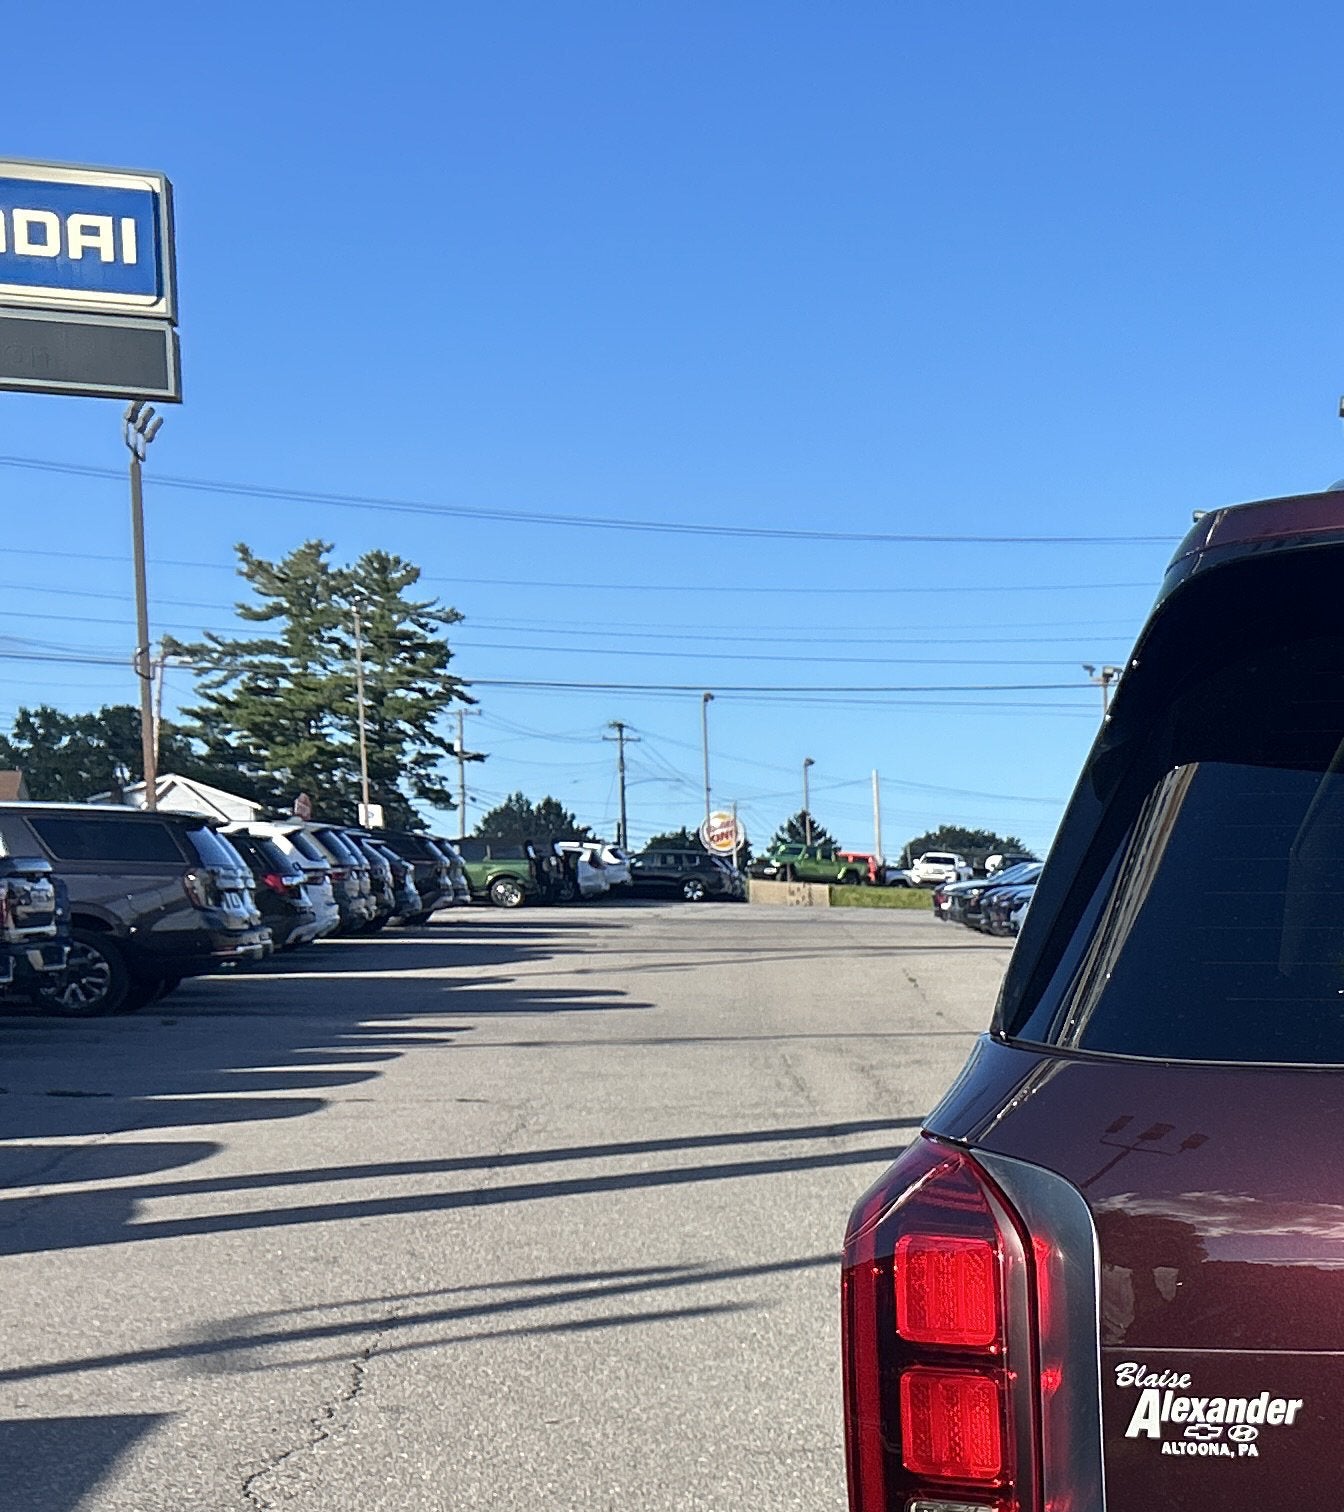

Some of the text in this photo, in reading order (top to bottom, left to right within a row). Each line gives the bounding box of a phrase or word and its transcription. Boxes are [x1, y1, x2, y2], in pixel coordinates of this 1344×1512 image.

[0, 207, 138, 265] DAI
[1114, 1362, 1193, 1389] Blaise
[1124, 1388, 1303, 1438] Alexander
[1161, 1441, 1259, 1459] ALTOONA, PA
